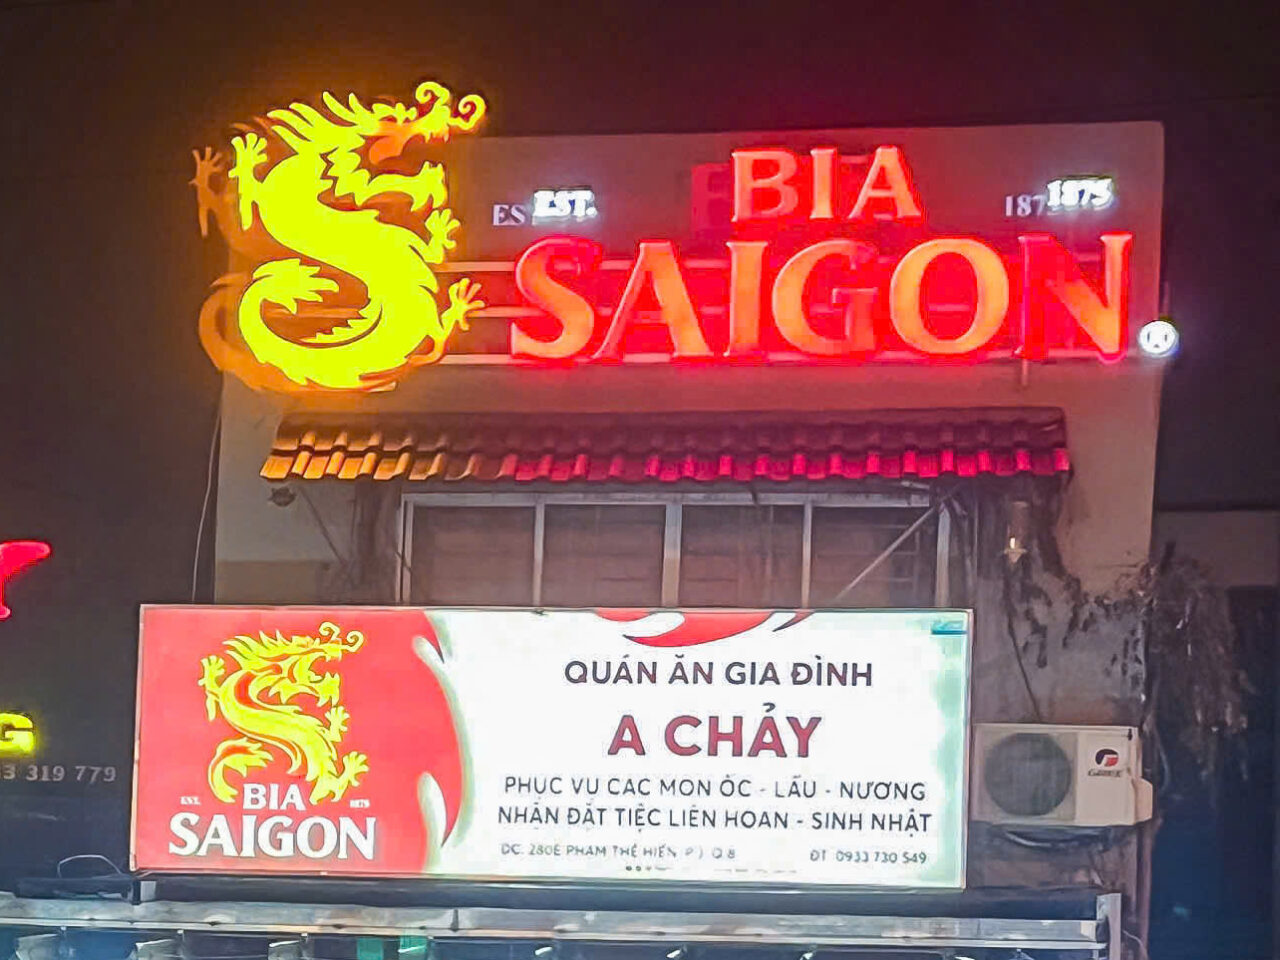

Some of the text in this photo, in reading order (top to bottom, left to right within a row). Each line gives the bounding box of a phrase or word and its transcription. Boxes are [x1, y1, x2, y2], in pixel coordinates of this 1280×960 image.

[733, 145, 920, 222] BIA
[513, 230, 1131, 362] SAIGON
[564, 653, 873, 687] QUÁN ĂN GIA ĐÌNH
[608, 702, 823, 758] A CHẢY
[26, 764, 66, 782] 319
[74, 766, 116, 784] 779
[242, 783, 307, 811] BIA
[169, 811, 377, 860] SAIGON
[725, 810, 789, 829] HOAN
[812, 812, 863, 831] SINH
